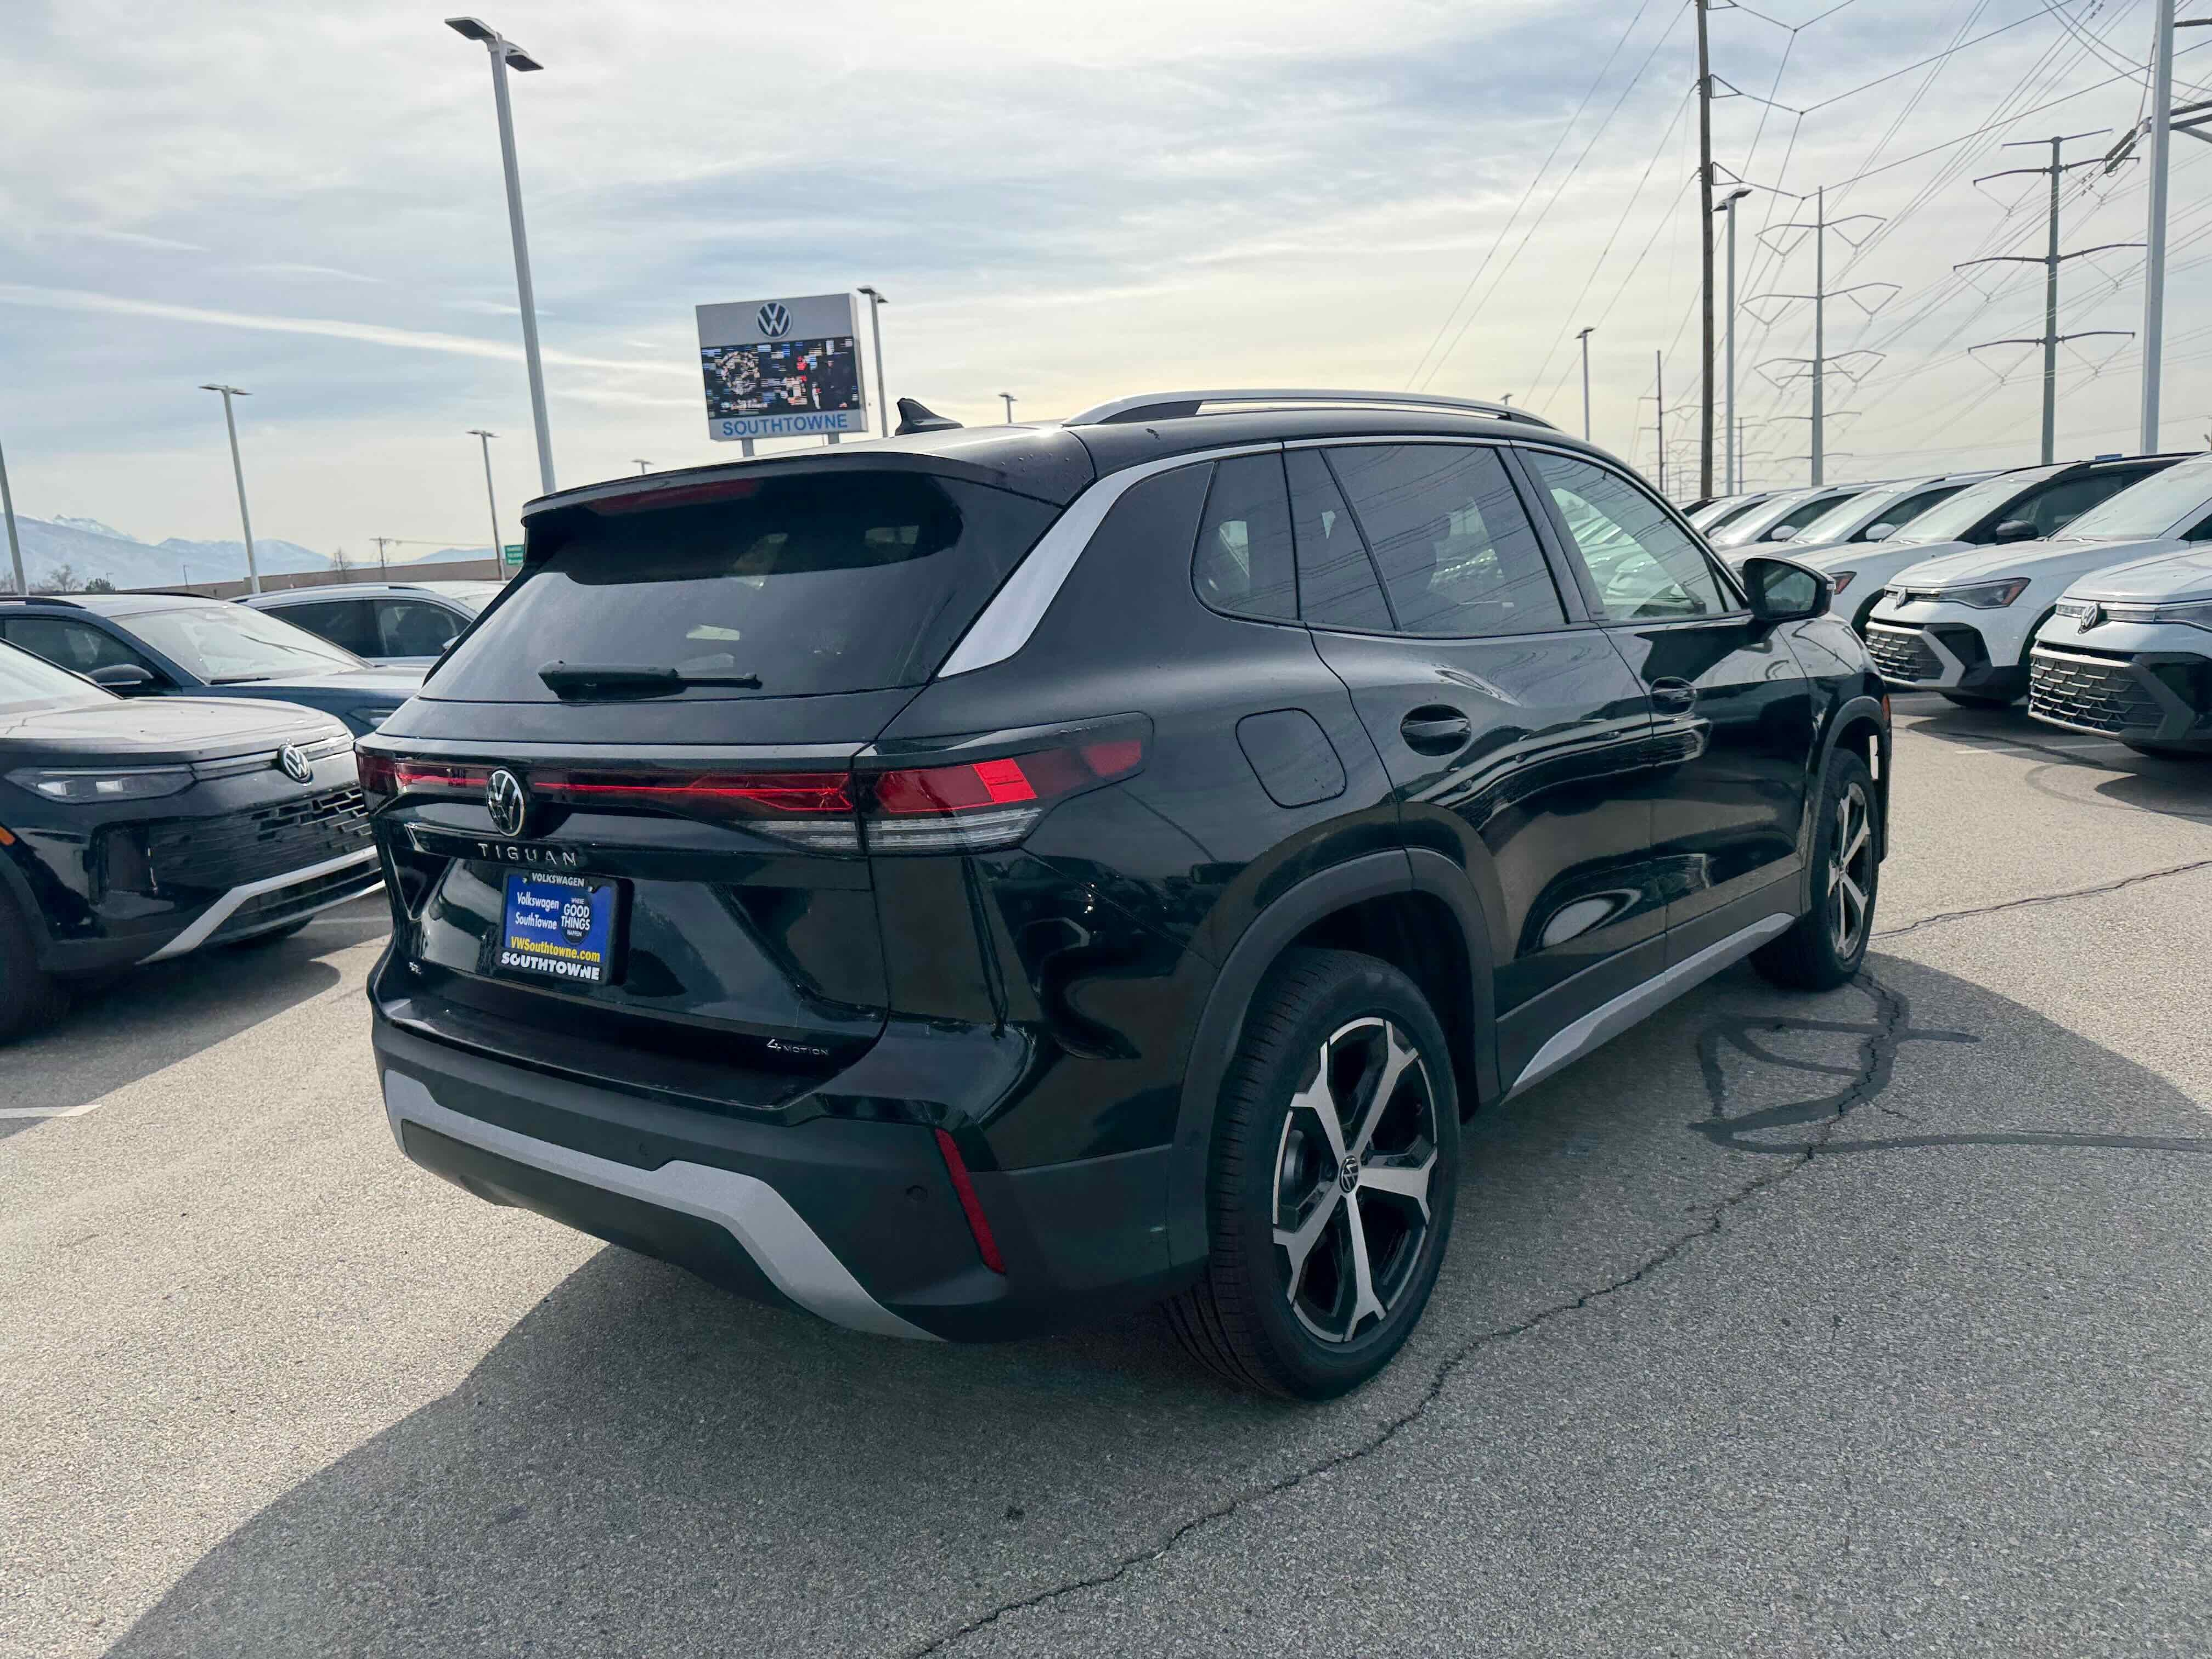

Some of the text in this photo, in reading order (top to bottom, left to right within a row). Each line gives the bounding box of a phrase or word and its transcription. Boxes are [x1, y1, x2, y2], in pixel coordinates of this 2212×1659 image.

[723, 414, 848, 436] SOUTHTOWNE
[478, 843, 577, 866] TIGUAN
[532, 872, 584, 887] VOLKSWAGEN
[517, 891, 560, 912] Volkswagen
[563, 904, 590, 918] GOOD
[515, 912, 557, 930] SouthTowne
[561, 916, 590, 931] THINGS
[511, 936, 600, 963] VWSouthtowne.com
[501, 952, 600, 981] SOUTHTOWNE
